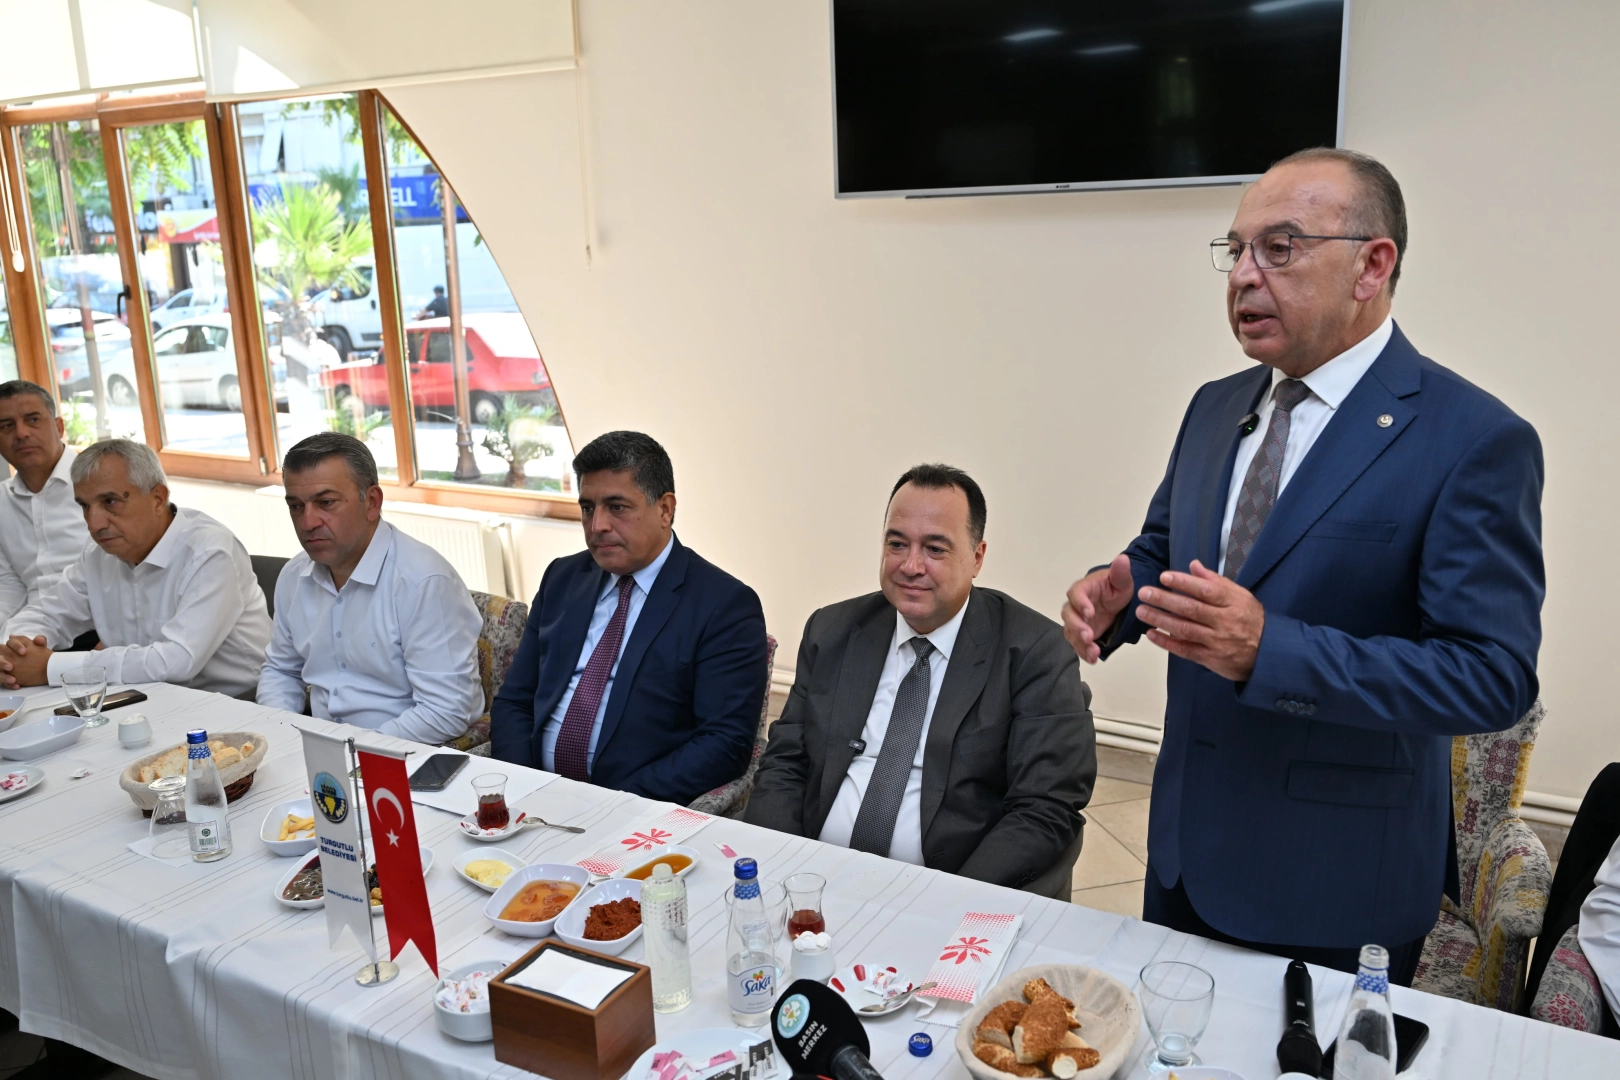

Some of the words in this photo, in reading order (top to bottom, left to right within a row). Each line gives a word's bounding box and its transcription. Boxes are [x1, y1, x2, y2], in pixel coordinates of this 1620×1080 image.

[320, 836, 354, 852] TURGUTLU
[320, 845, 357, 862] BELEDİYESİ
[327, 888, 364, 903] www.turgutlu.bel.tr
[743, 976, 771, 997] Saka
[798, 1020, 819, 1048] BASIN
[801, 1024, 828, 1060] MERKEZ
